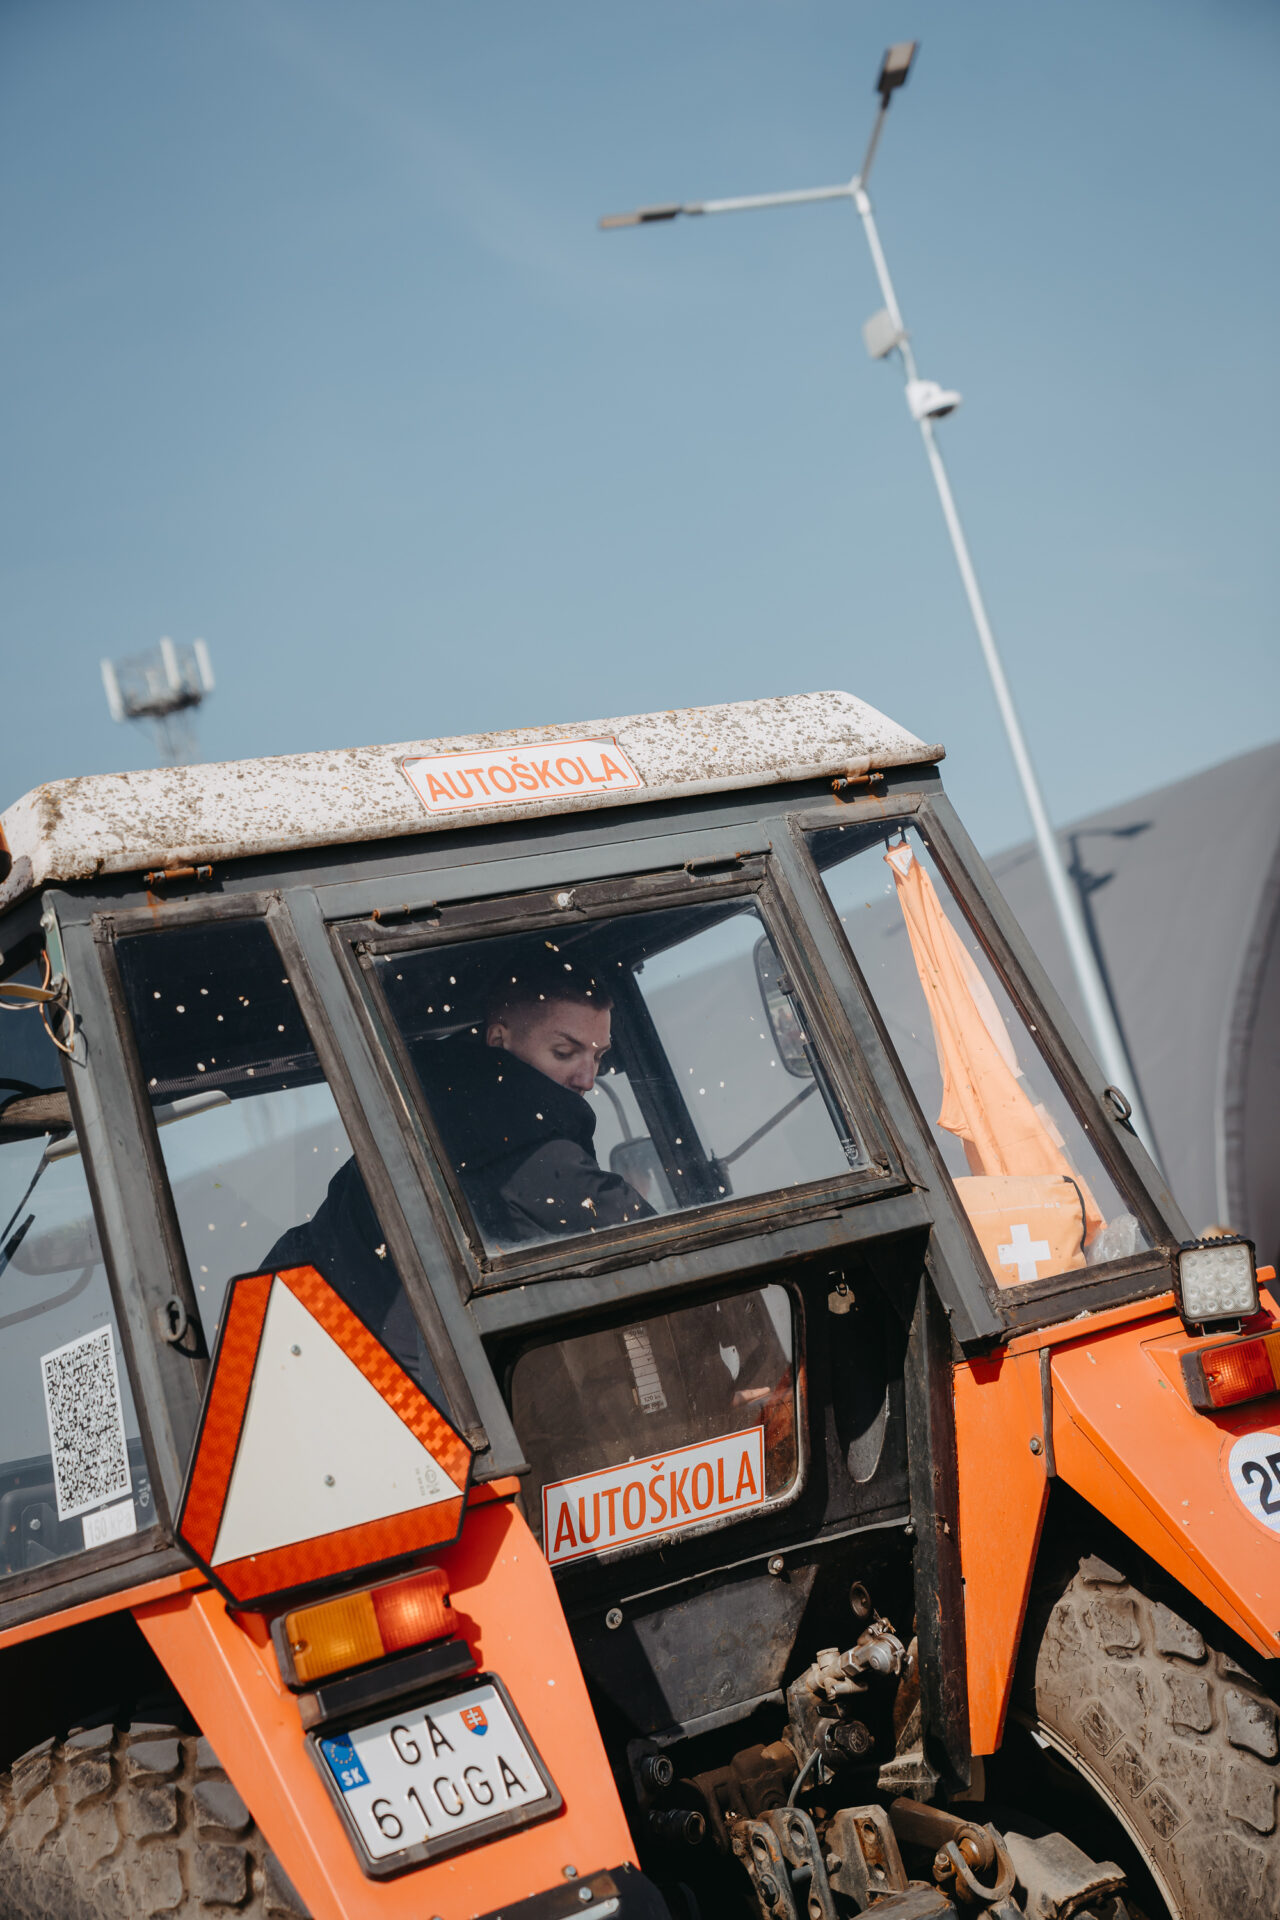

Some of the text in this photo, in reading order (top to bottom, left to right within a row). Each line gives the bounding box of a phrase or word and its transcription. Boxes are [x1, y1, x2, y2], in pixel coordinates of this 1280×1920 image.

[425, 753, 629, 802] AUTOŠKOLA
[553, 1450, 758, 1553] AUTOŠKOLA
[390, 1714, 454, 1765] GA
[341, 1766, 364, 1787] SK
[371, 1755, 527, 1839] 610GA
